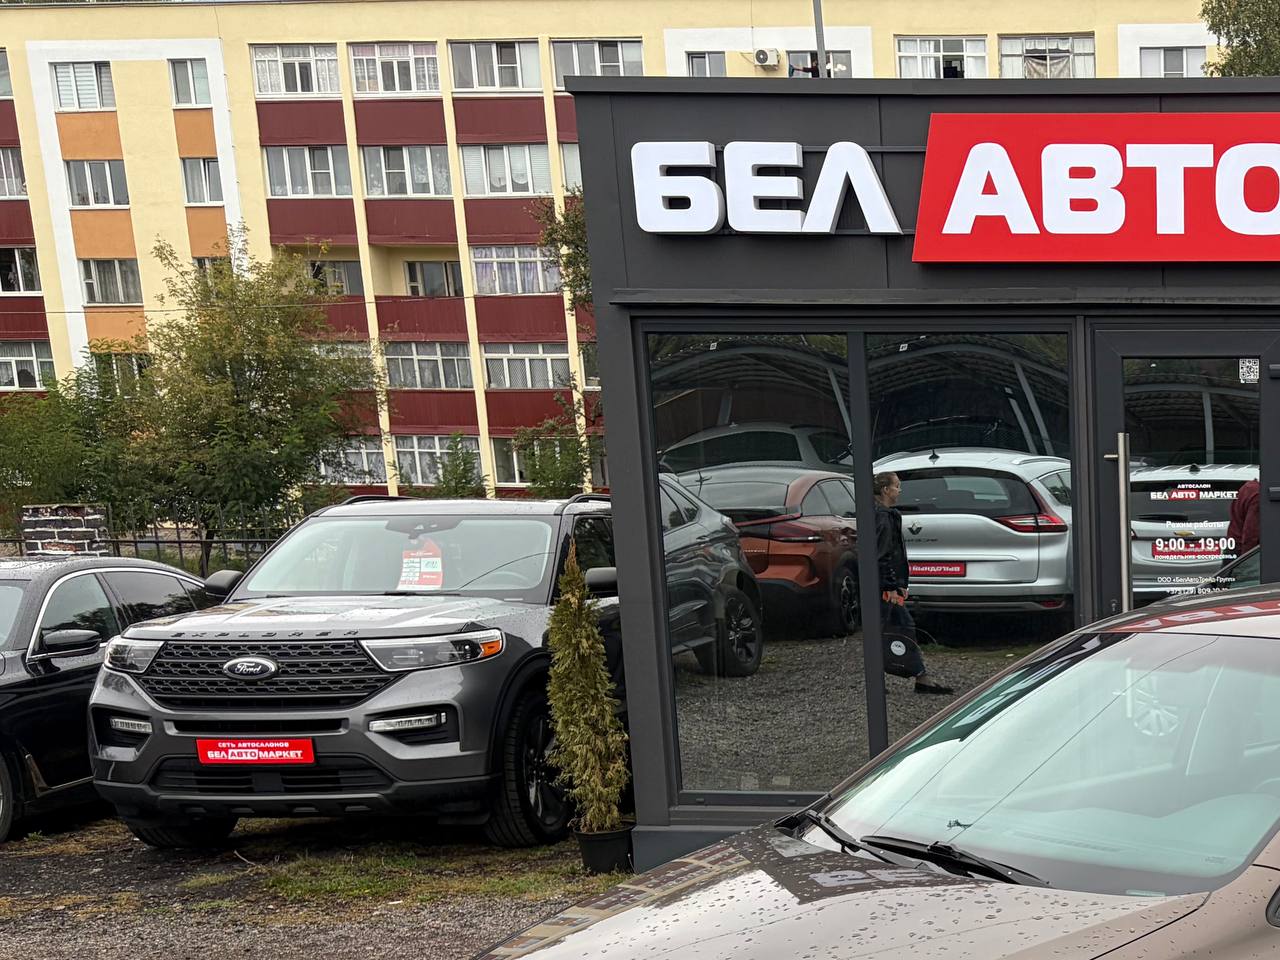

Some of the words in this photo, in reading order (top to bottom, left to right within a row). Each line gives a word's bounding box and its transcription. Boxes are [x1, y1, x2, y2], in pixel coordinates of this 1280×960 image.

[631, 141, 902, 235] БЕЛ
[1200, 491, 1238, 499] МАРКЕТ
[1155, 538, 1185, 550] 9:00
[1199, 538, 1236, 550] 19:00
[235, 662, 262, 674] Ford
[208, 750, 228, 758] БЕЛ
[230, 750, 257, 758] АВТО
[259, 750, 304, 759] МАРКЕТ
